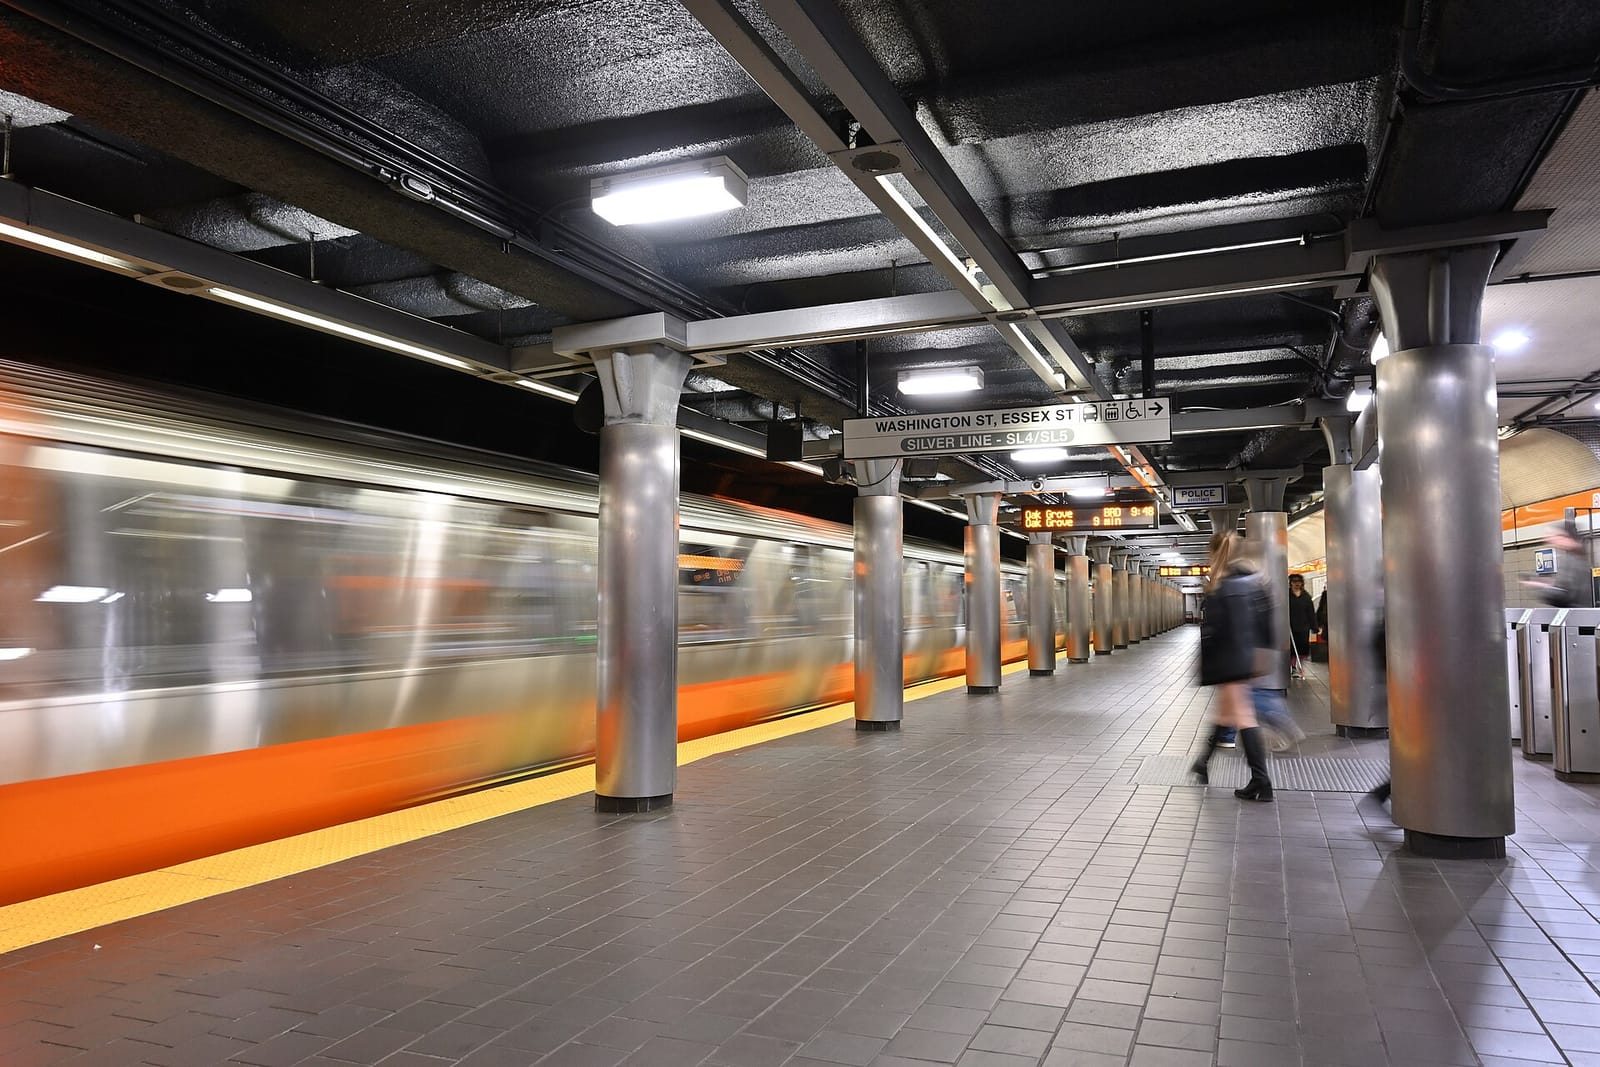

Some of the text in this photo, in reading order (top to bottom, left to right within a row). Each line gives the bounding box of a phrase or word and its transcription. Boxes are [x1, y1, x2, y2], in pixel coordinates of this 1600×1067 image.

[875, 409, 1074, 433] WASHINGTON ST, ESSEX ST
[907, 436, 955, 451] SILVER
[960, 434, 993, 448] LINE
[1006, 430, 1069, 445] SL4/SL5
[1181, 489, 1216, 498] POLICE
[1025, 510, 1042, 520] Oak
[1045, 509, 1074, 519] Grove
[1025, 519, 1042, 528] Oak
[1045, 518, 1074, 528] Grove
[1103, 517, 1122, 527] min
